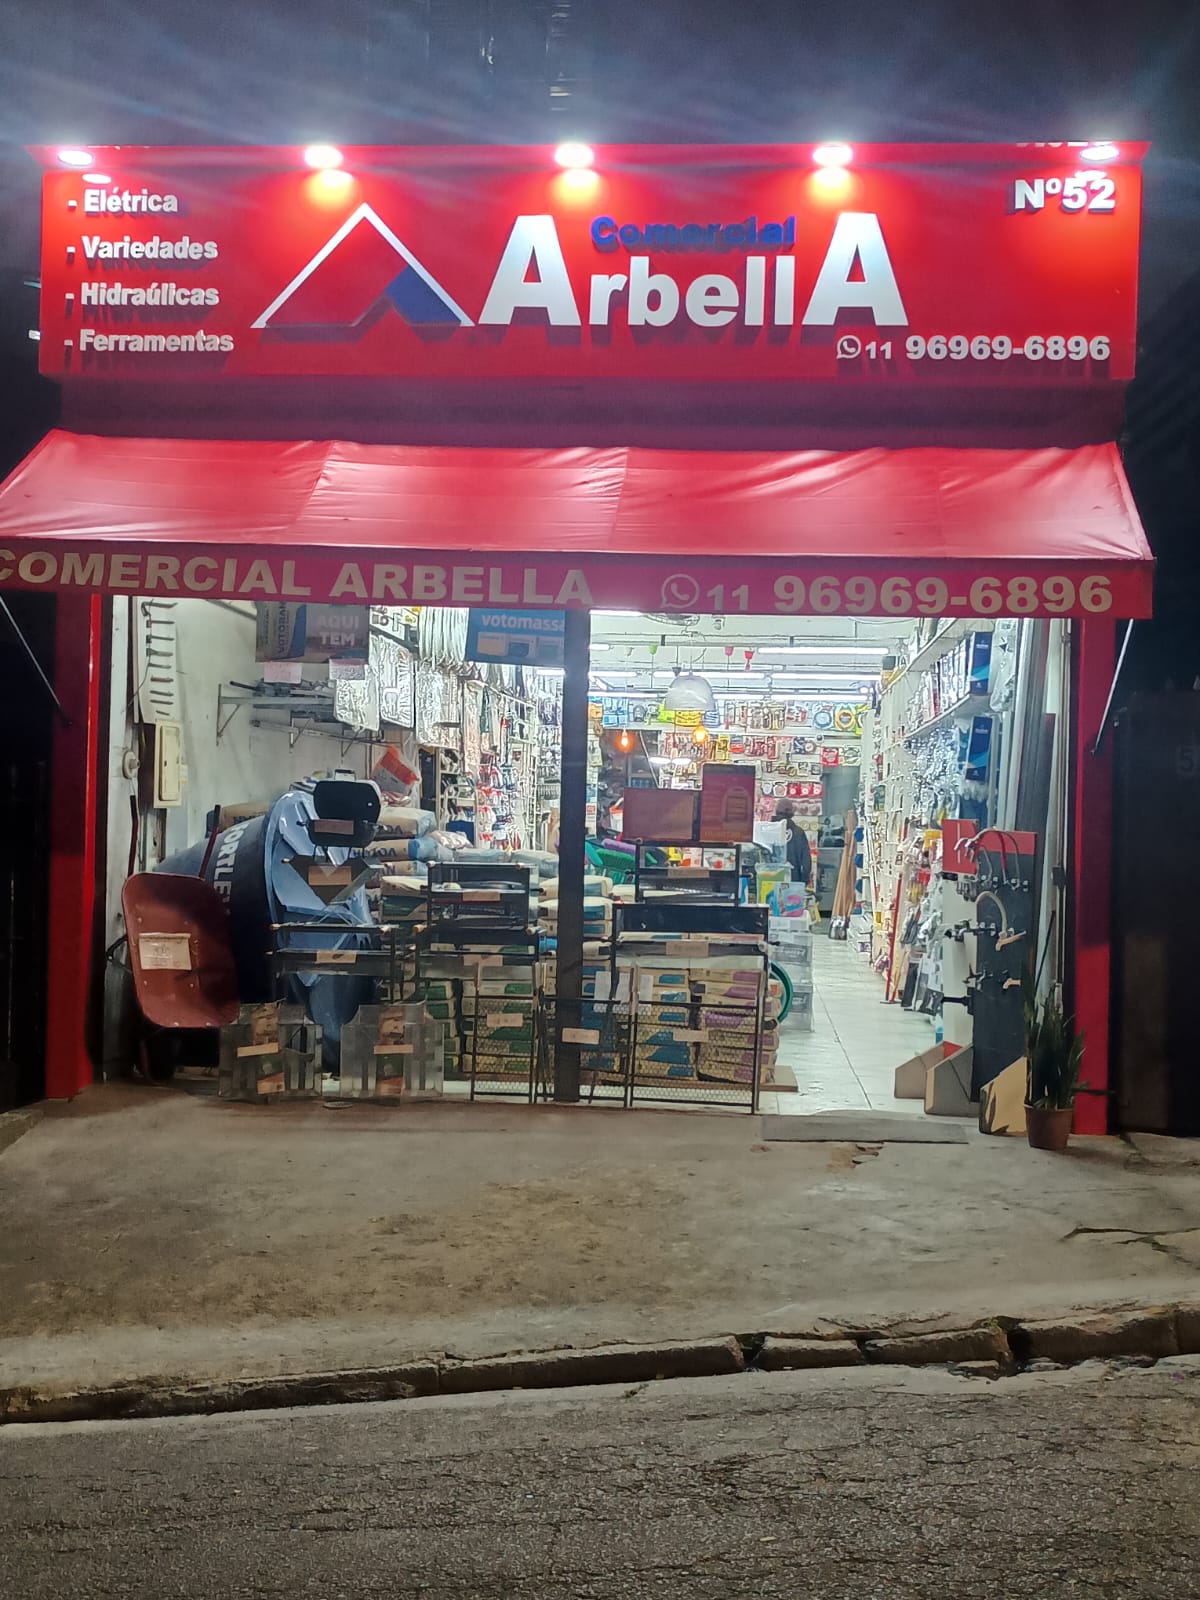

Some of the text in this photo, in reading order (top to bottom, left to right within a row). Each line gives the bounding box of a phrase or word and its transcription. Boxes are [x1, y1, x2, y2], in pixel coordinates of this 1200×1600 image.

[84, 187, 178, 212] Elétrica
[590, 216, 796, 246] Comercial
[82, 236, 218, 260] Variedades
[478, 212, 908, 327] ArbellA
[80, 282, 220, 306] Hidraúlicas
[79, 329, 234, 352] Ferramentas
[865, 335, 1111, 361] 11 96969-6896
[328, 562, 594, 605] ARBELLA
[706, 575, 1113, 614] 11 96969-6896
[317, 615, 360, 629] AQUI
[319, 631, 355, 646] TEM
[213, 822, 250, 903] ORTLE
